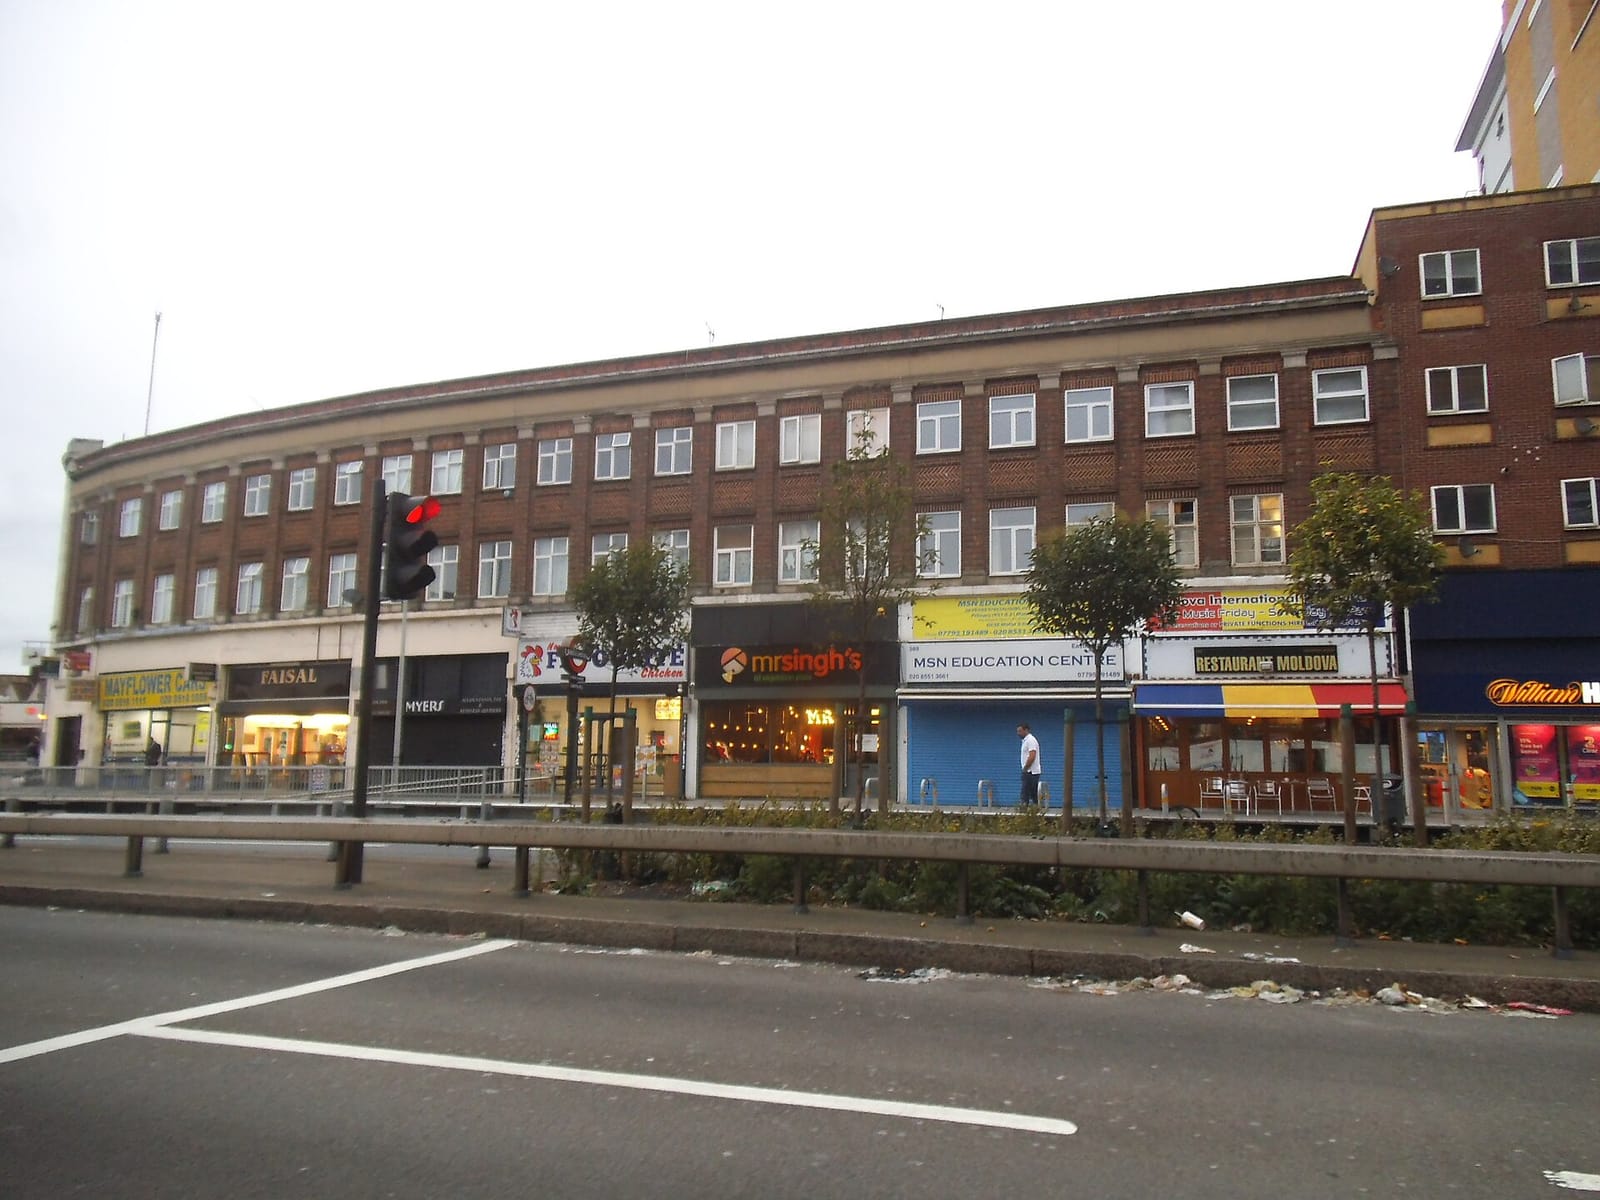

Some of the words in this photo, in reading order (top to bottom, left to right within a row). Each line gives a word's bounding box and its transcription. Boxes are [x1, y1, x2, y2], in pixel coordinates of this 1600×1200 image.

[1209, 594, 1300, 605] International
[1183, 608, 1216, 619] Music
[1218, 608, 1256, 619] Friday
[752, 648, 863, 677] mrsingh's
[914, 657, 947, 668] MSN
[951, 655, 1044, 668] EDUCATION
[1277, 655, 1338, 671] MOLDOVA
[261, 668, 318, 685] FAISAL
[640, 667, 684, 679] Chicken
[104, 673, 171, 696] MAYFLOWER
[1488, 679, 1581, 704] William
[405, 700, 445, 713] MYERS
[805, 708, 835, 725] MR
